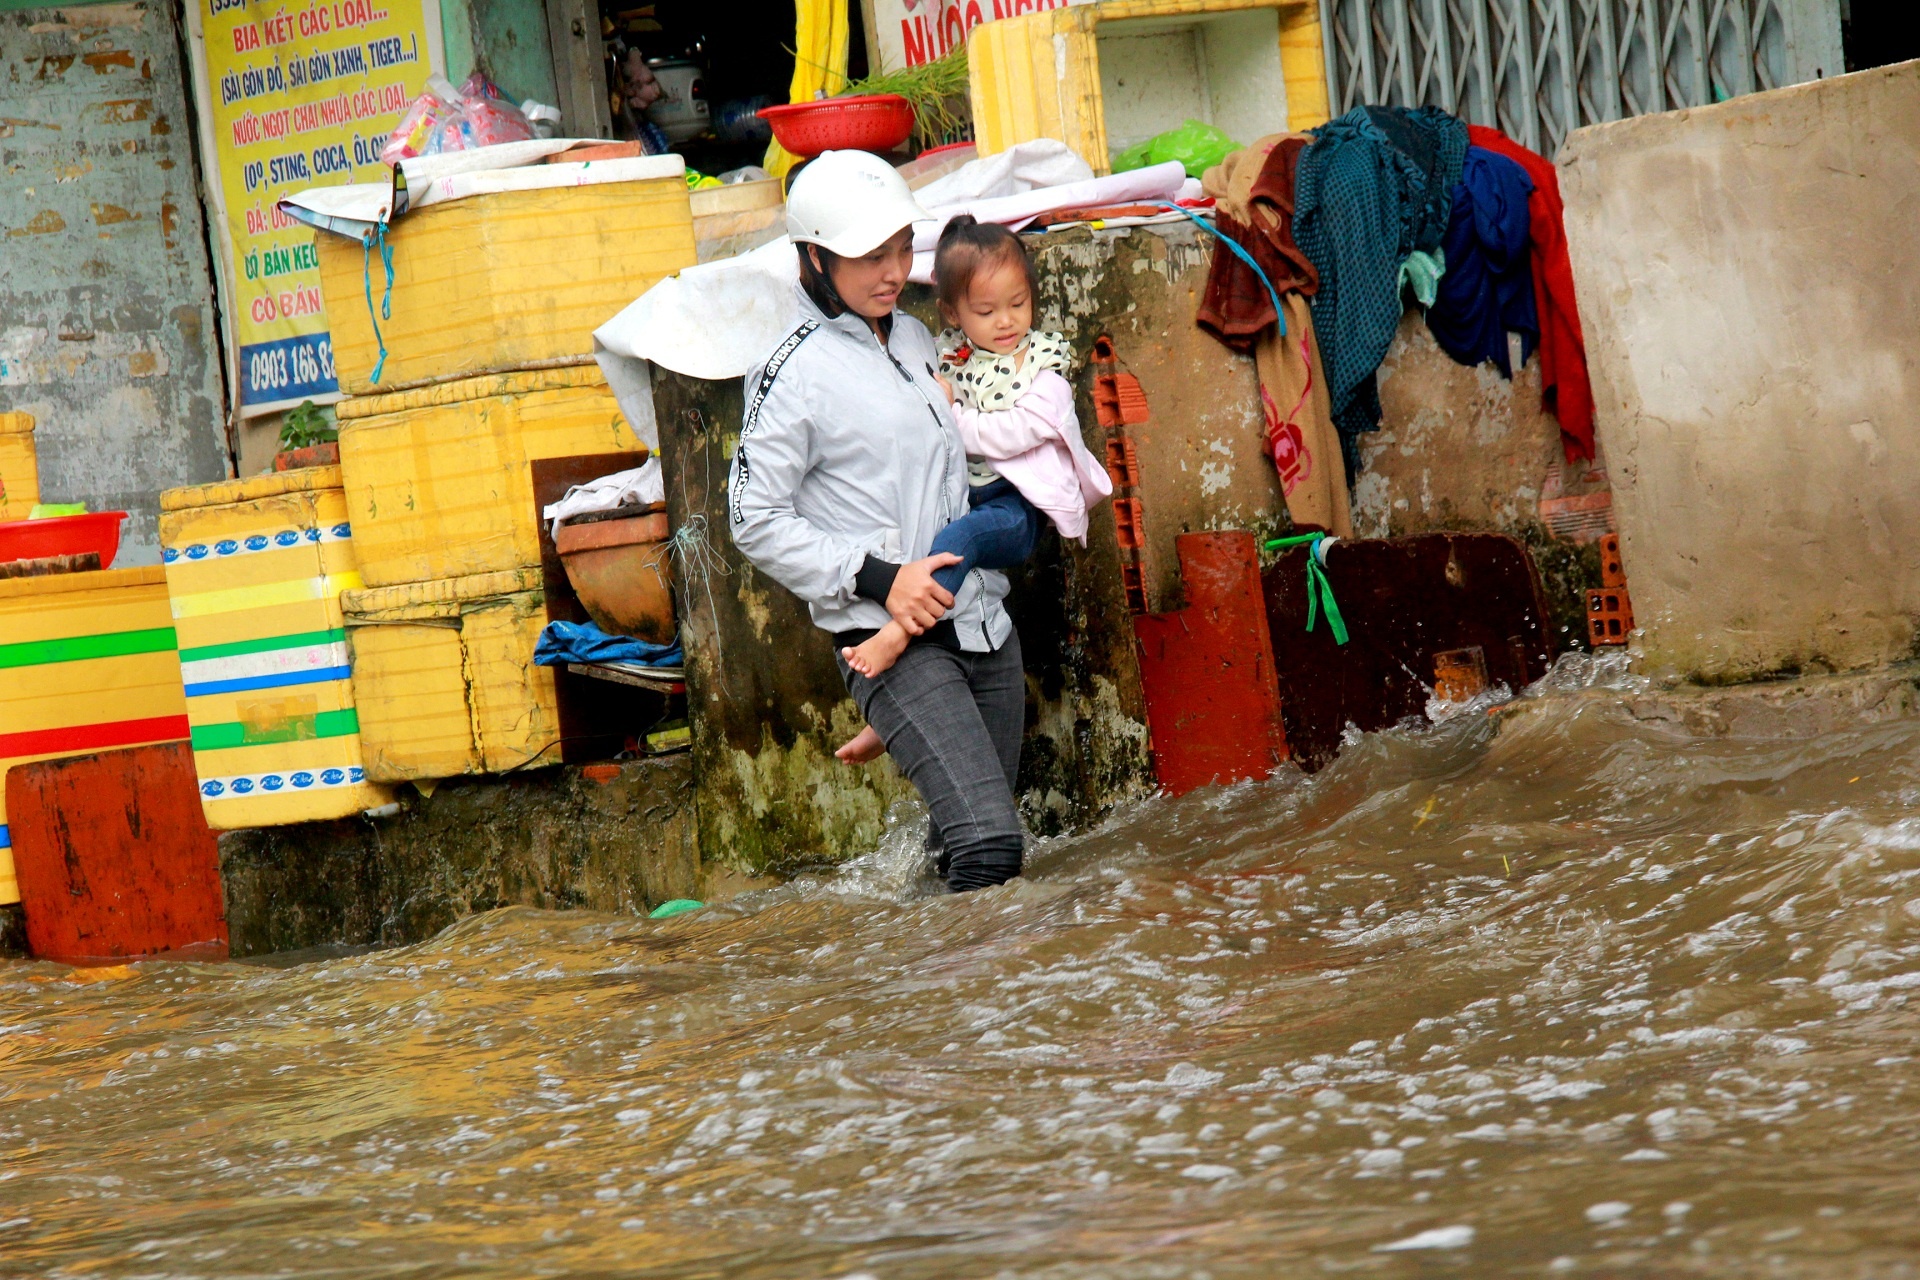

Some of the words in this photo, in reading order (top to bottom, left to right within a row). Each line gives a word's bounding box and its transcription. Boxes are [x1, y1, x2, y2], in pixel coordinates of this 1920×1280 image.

[233, 24, 260, 53] BIA
[264, 6, 294, 46] KẾT
[299, 2, 330, 37] CÁC
[242, 64, 265, 98] GÒN
[266, 55, 288, 94] ĐỎ,
[288, 54, 308, 87] SÀI
[308, 48, 332, 82] GÒN
[332, 46, 368, 75] XANH,
[233, 111, 261, 146] NƯỚC
[261, 109, 291, 141] NGỌT
[293, 103, 319, 132] CHAI
[320, 92, 352, 128] NHỰA
[353, 84, 377, 119] CÁC
[269, 152, 311, 184] STING,
[313, 144, 352, 174] COCA,
[244, 247, 259, 280] CÓ
[263, 243, 291, 276] BÁN
[279, 283, 321, 318] BÁN
[250, 347, 288, 391] 0903
[291, 343, 319, 384] 166
[766, 334, 802, 377] GIVENCHY
[734, 465, 748, 522] GIVENCHY
